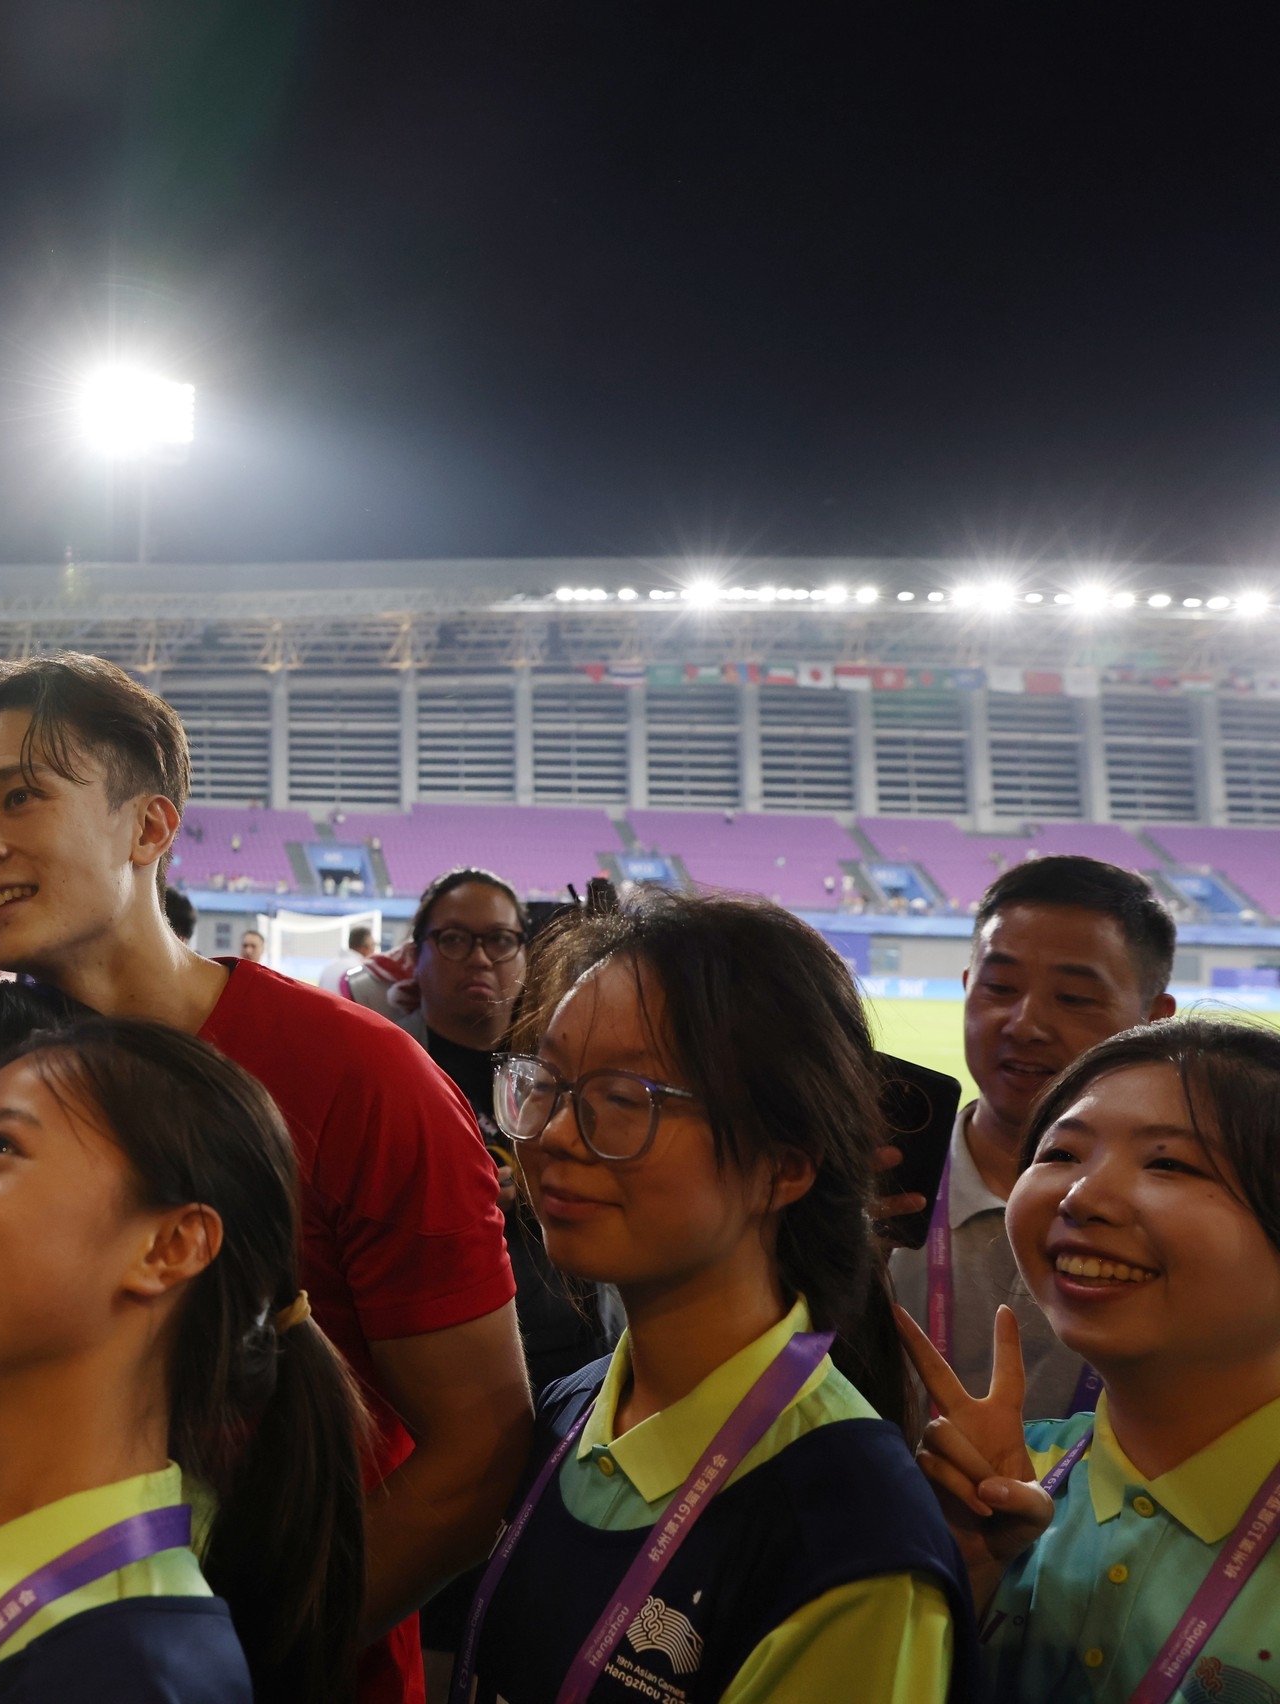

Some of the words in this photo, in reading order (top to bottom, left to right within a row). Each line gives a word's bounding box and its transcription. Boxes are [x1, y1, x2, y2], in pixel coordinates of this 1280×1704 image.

[648, 1454, 728, 1562] 杭州第19届亚运会
[589, 1606, 629, 1667] Hangzhou
[1164, 1620, 1207, 1678] Hangzhou
[604, 1661, 660, 1700] Hangzhou
[617, 1654, 634, 1671] 19th
[633, 1663, 657, 1684] Asian
[658, 1678, 686, 1700] Games
